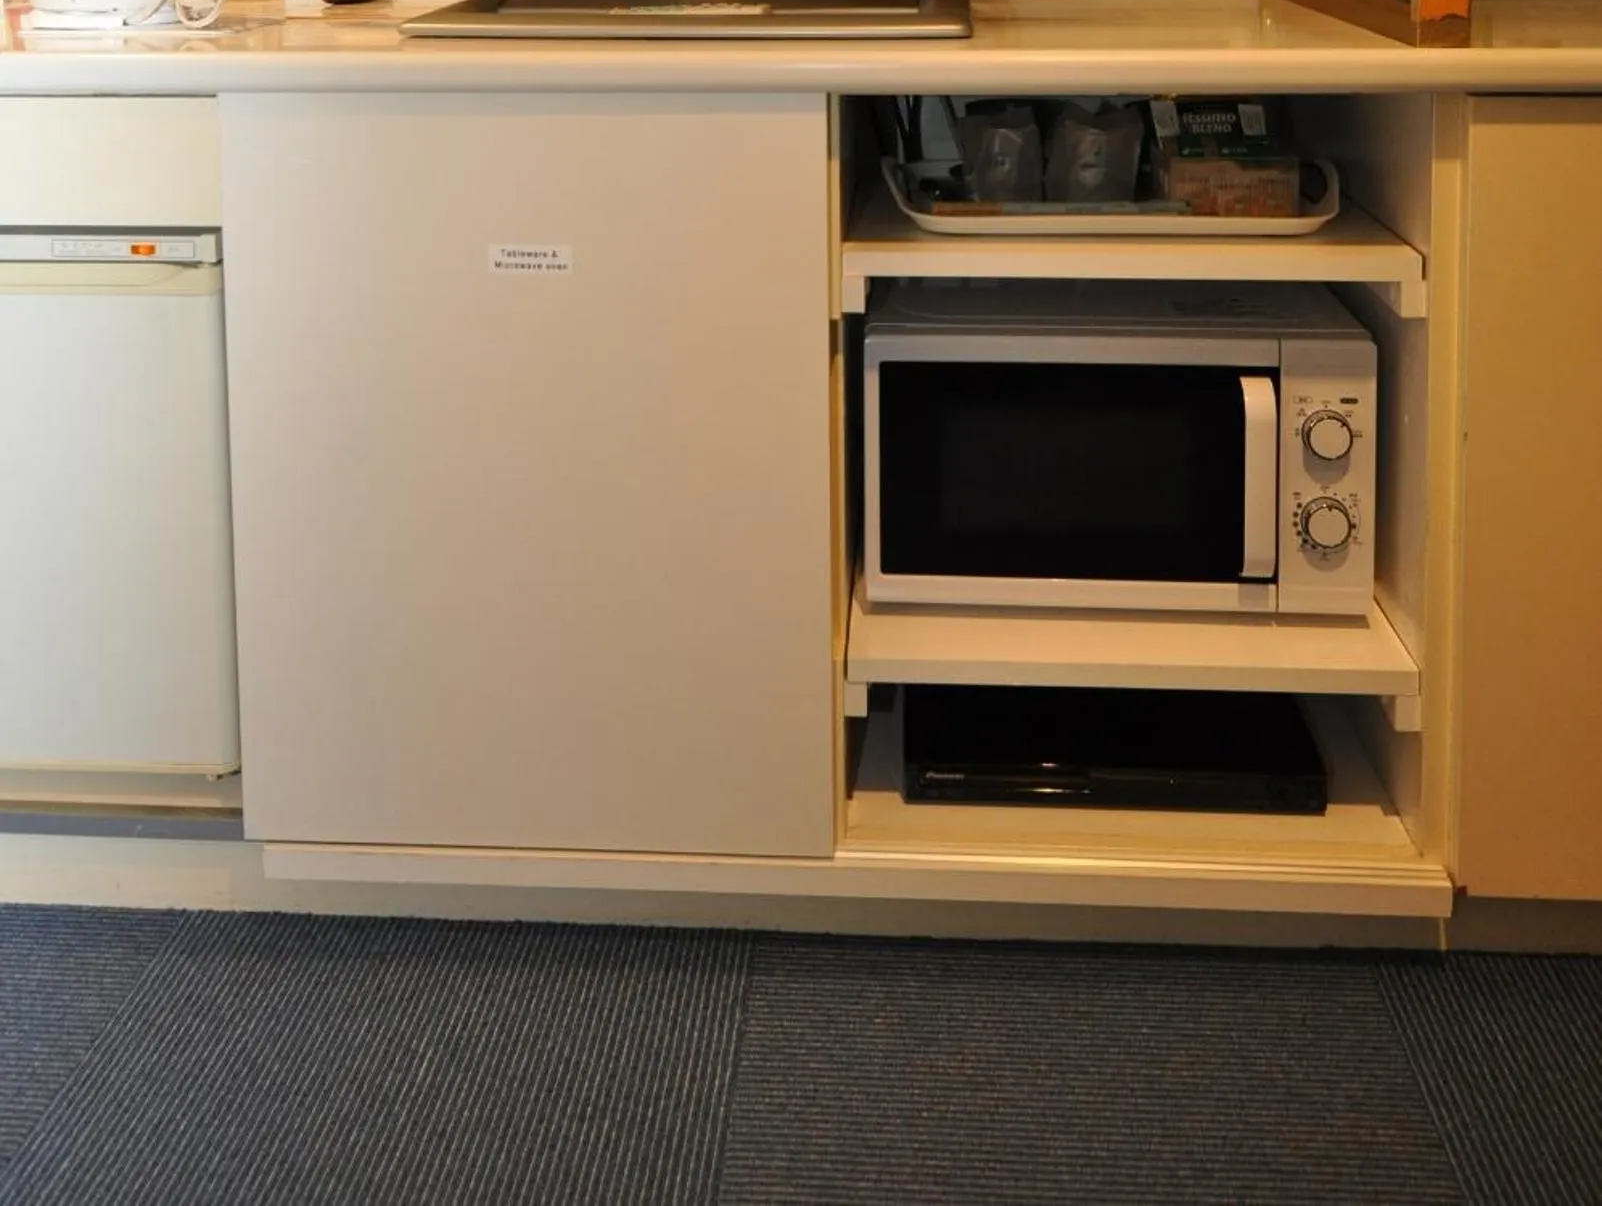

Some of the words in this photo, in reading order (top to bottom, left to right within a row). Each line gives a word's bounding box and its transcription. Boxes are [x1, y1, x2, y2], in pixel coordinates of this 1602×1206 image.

[501, 248, 548, 258] Tableware
[551, 249, 559, 258] &
[494, 260, 543, 270] Microwave
[545, 263, 568, 271] oven
